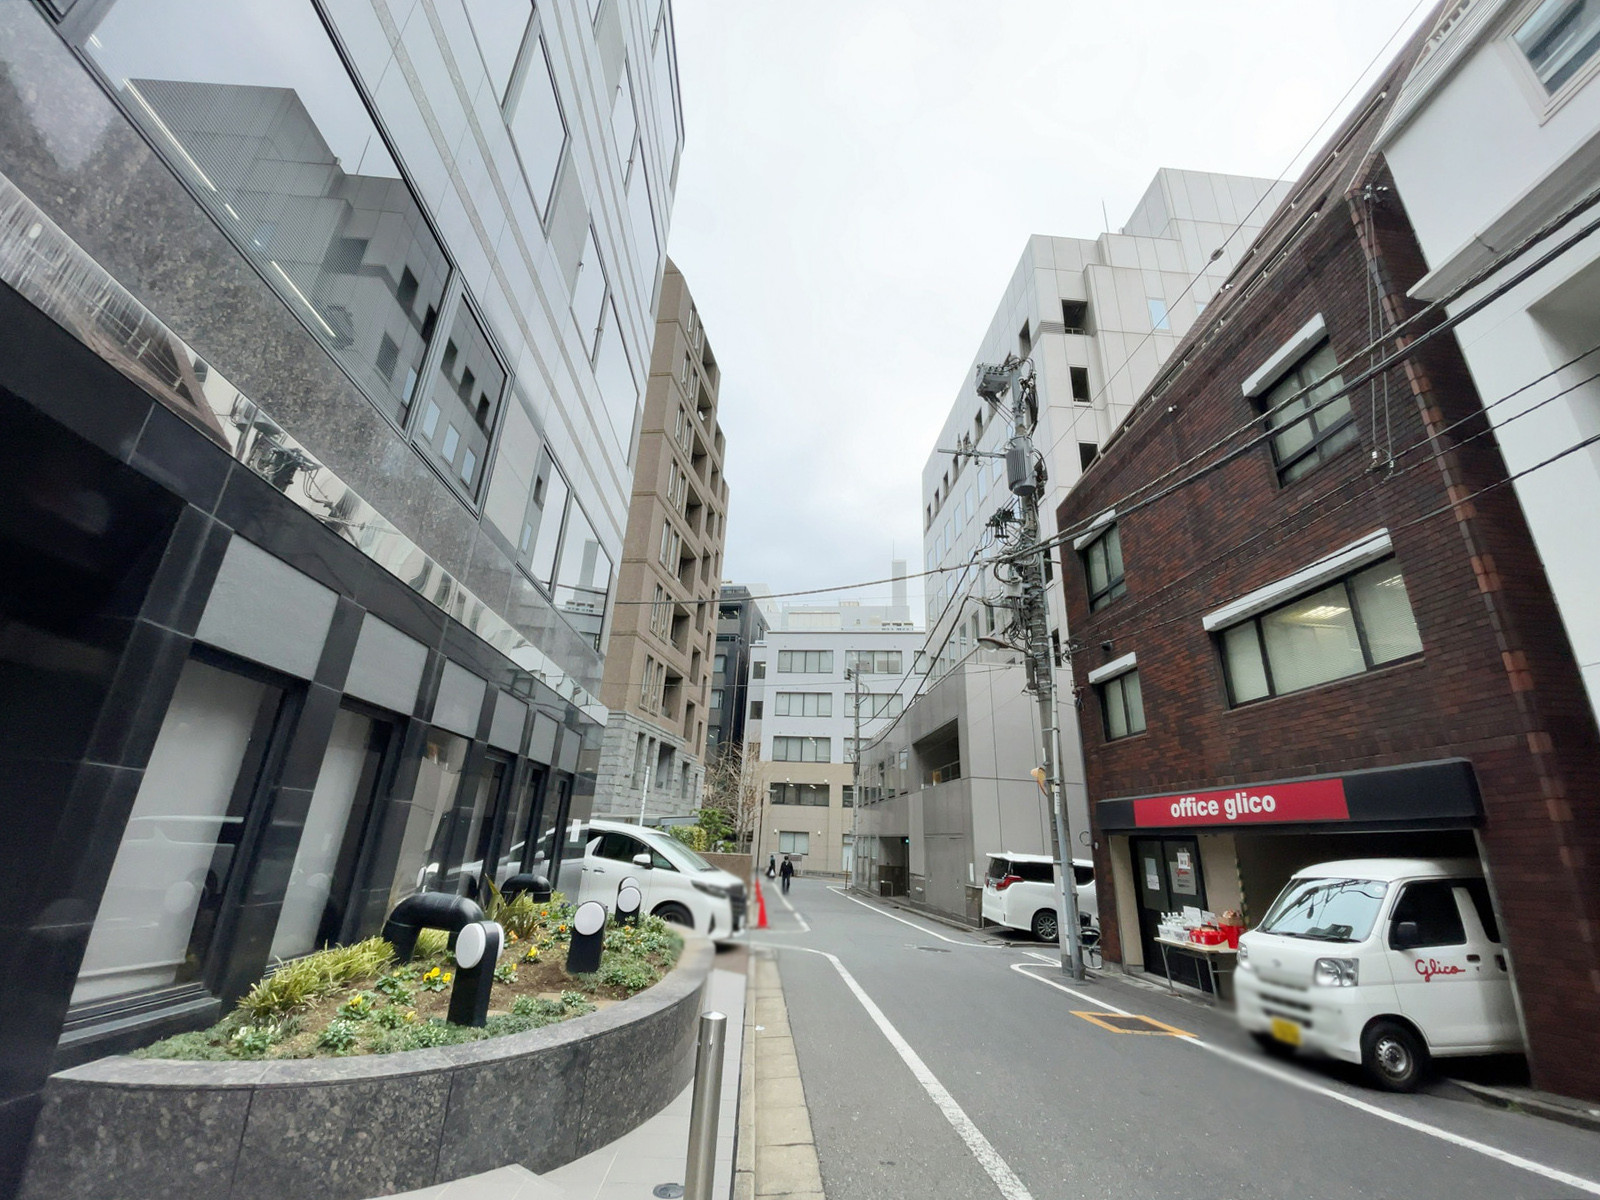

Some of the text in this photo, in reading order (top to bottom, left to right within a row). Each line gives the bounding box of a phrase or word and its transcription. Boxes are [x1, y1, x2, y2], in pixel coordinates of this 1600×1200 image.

[1170, 791, 1276, 820] office glico
[1415, 958, 1466, 983] Glico
